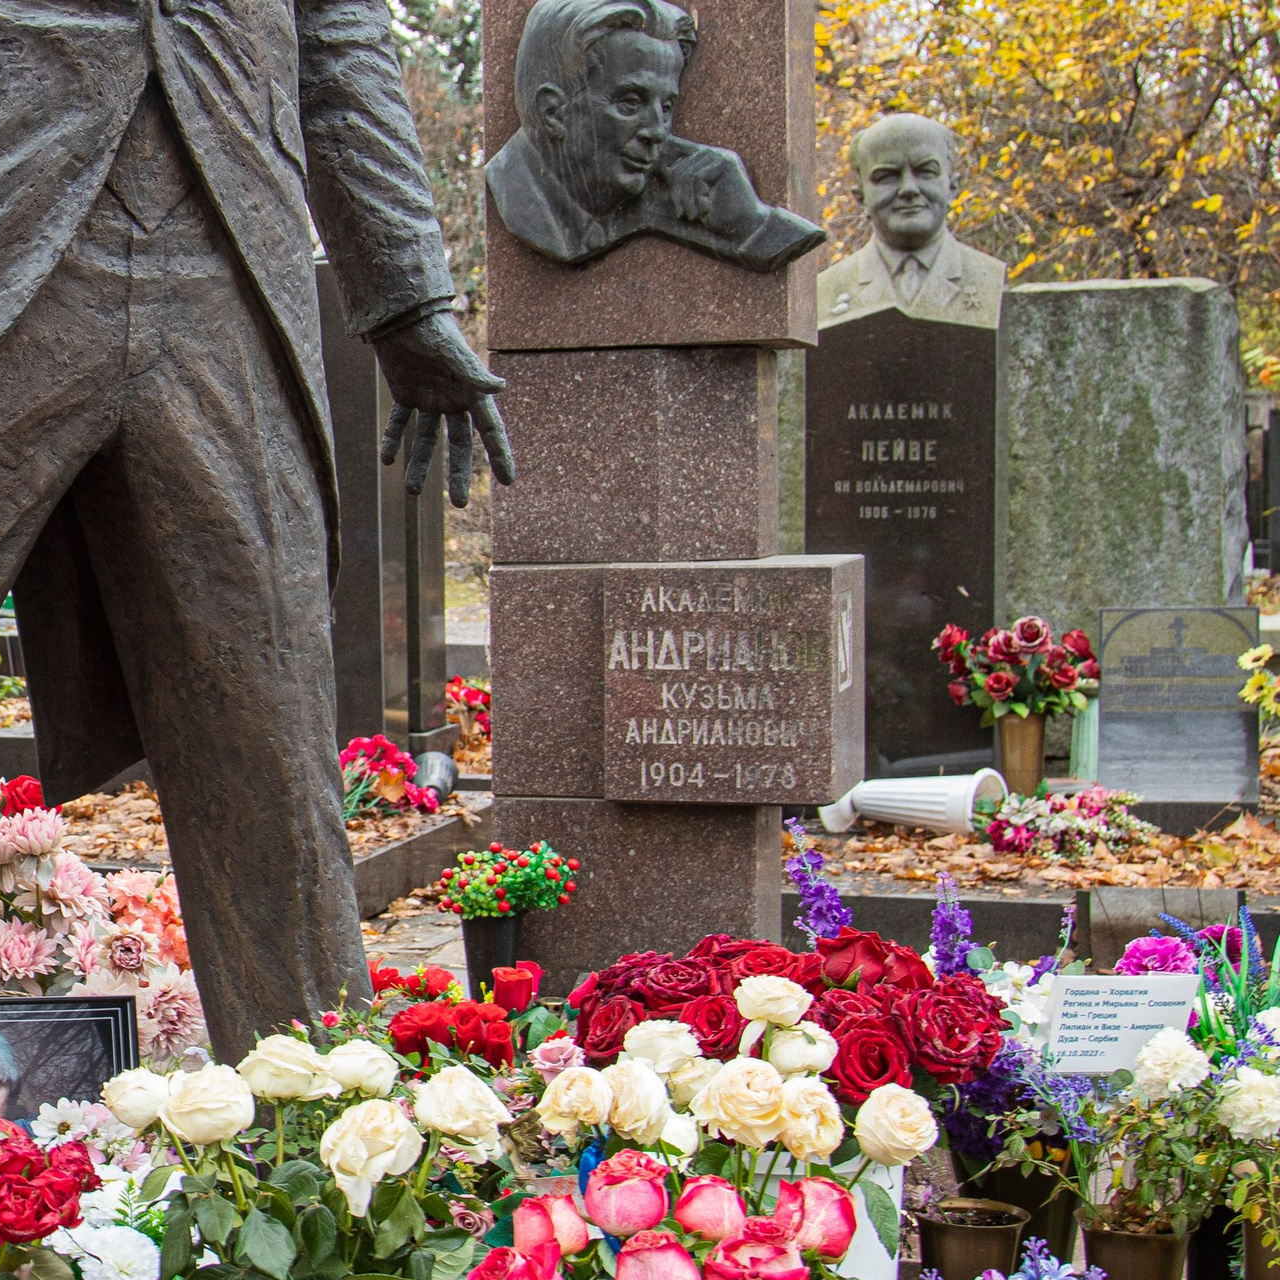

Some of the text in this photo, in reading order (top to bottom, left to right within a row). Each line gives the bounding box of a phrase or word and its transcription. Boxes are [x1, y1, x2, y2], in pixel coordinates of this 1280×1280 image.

[846, 402, 953, 420] АКАДЕМИК
[861, 437, 938, 462] ПЕЙВЕ
[608, 629, 831, 671] АНДРИАНОВ
[660, 682, 775, 710] КУЗЬМА
[625, 717, 817, 747] АНДРИАНОВИЧ
[1064, 988, 1100, 997] Гордана
[1109, 988, 1148, 997] Хорватия
[1062, 1000, 1092, 1008] Регина
[1147, 999, 1186, 1008] Словения
[1087, 1012, 1117, 1020] Греция
[1129, 1023, 1165, 1031] Америка
[1057, 1035, 1079, 1044] Дуда
[1088, 1034, 1119, 1043] Сербия
